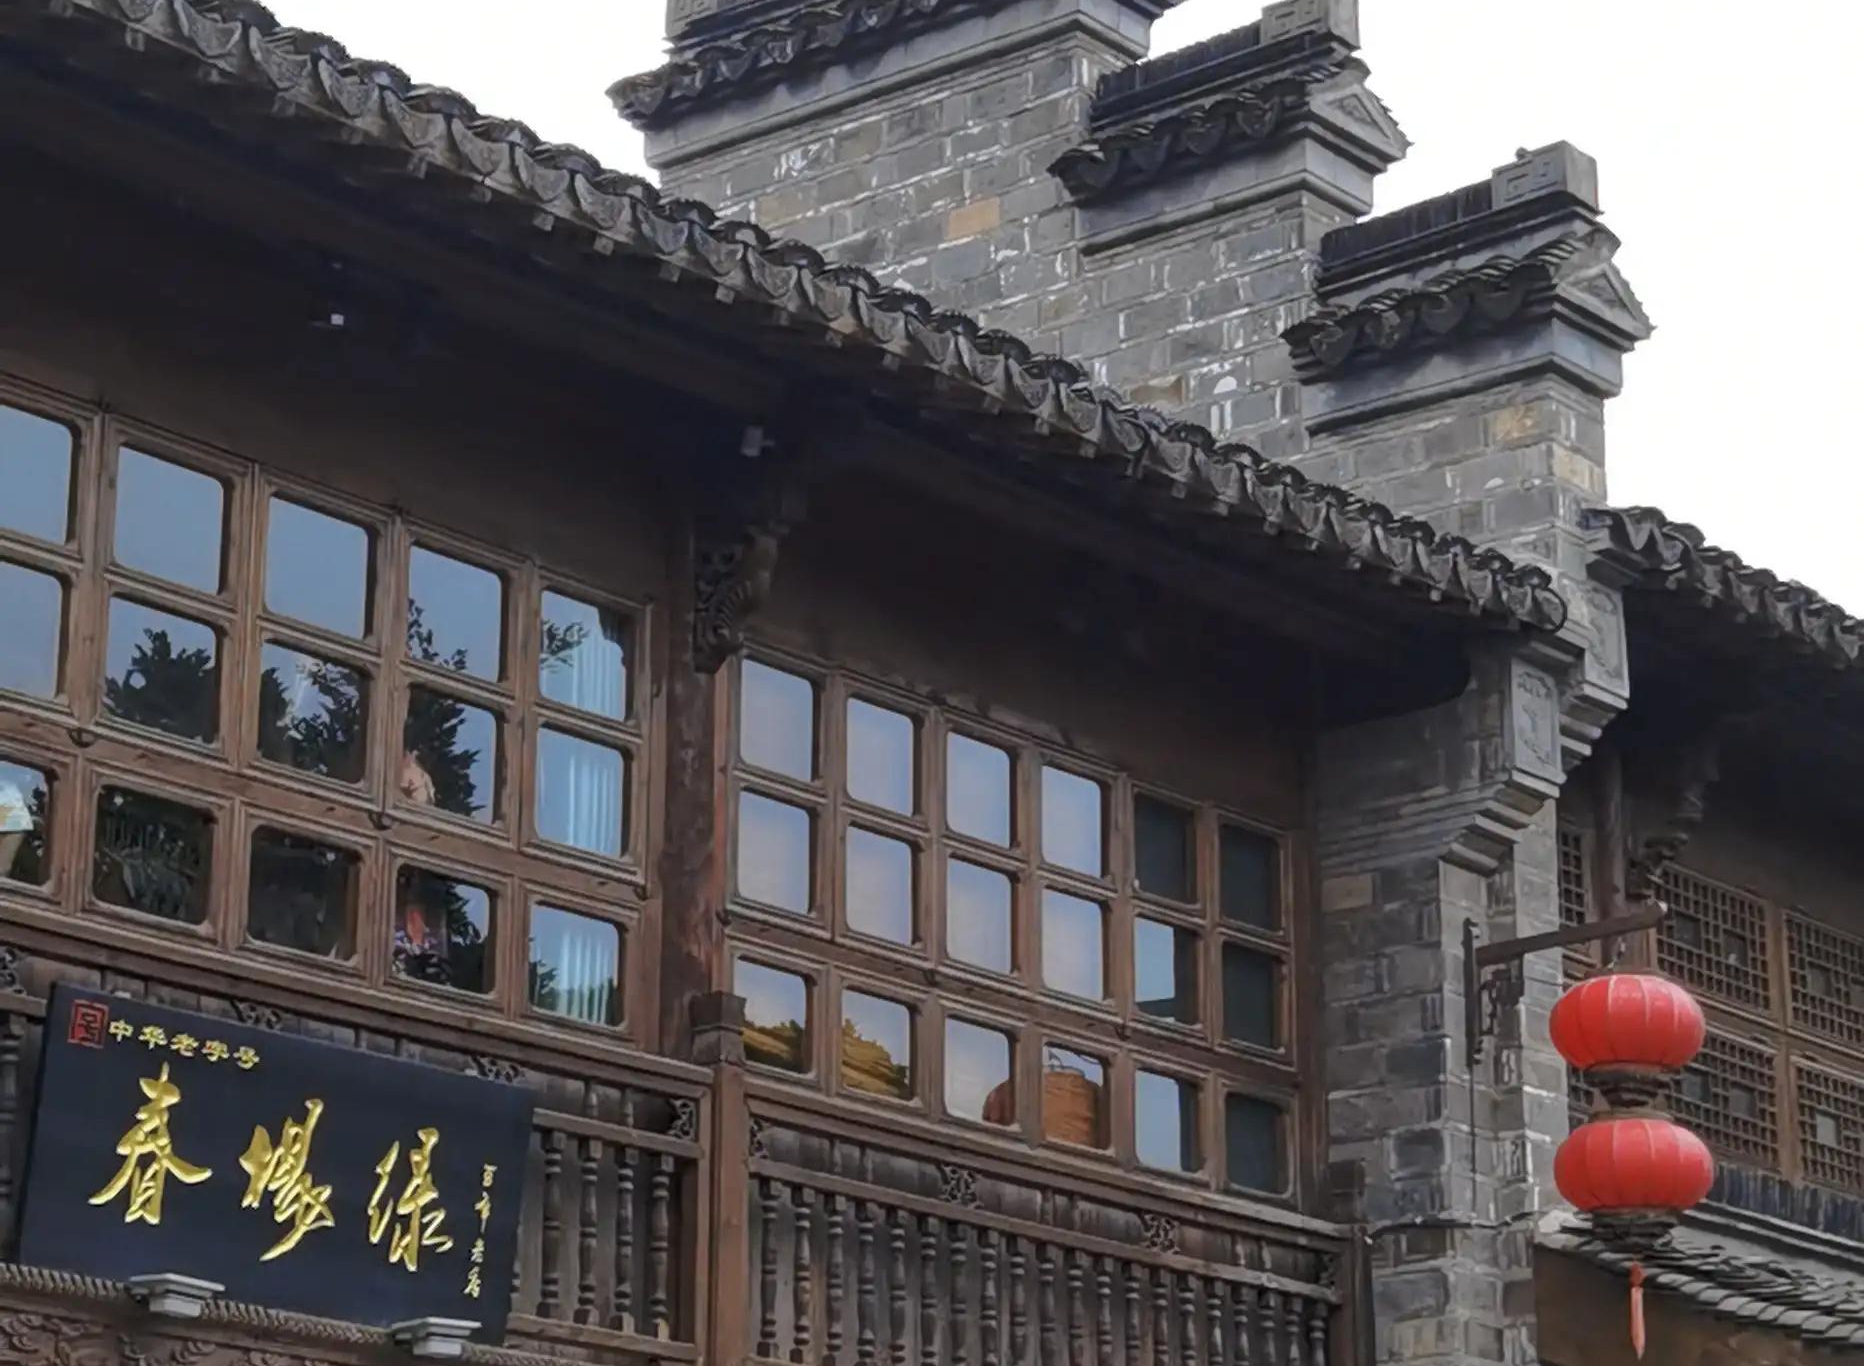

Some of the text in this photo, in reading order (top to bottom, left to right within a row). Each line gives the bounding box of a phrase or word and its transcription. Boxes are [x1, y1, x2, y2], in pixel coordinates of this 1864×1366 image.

[108, 1017, 260, 1070] 中华老字号
